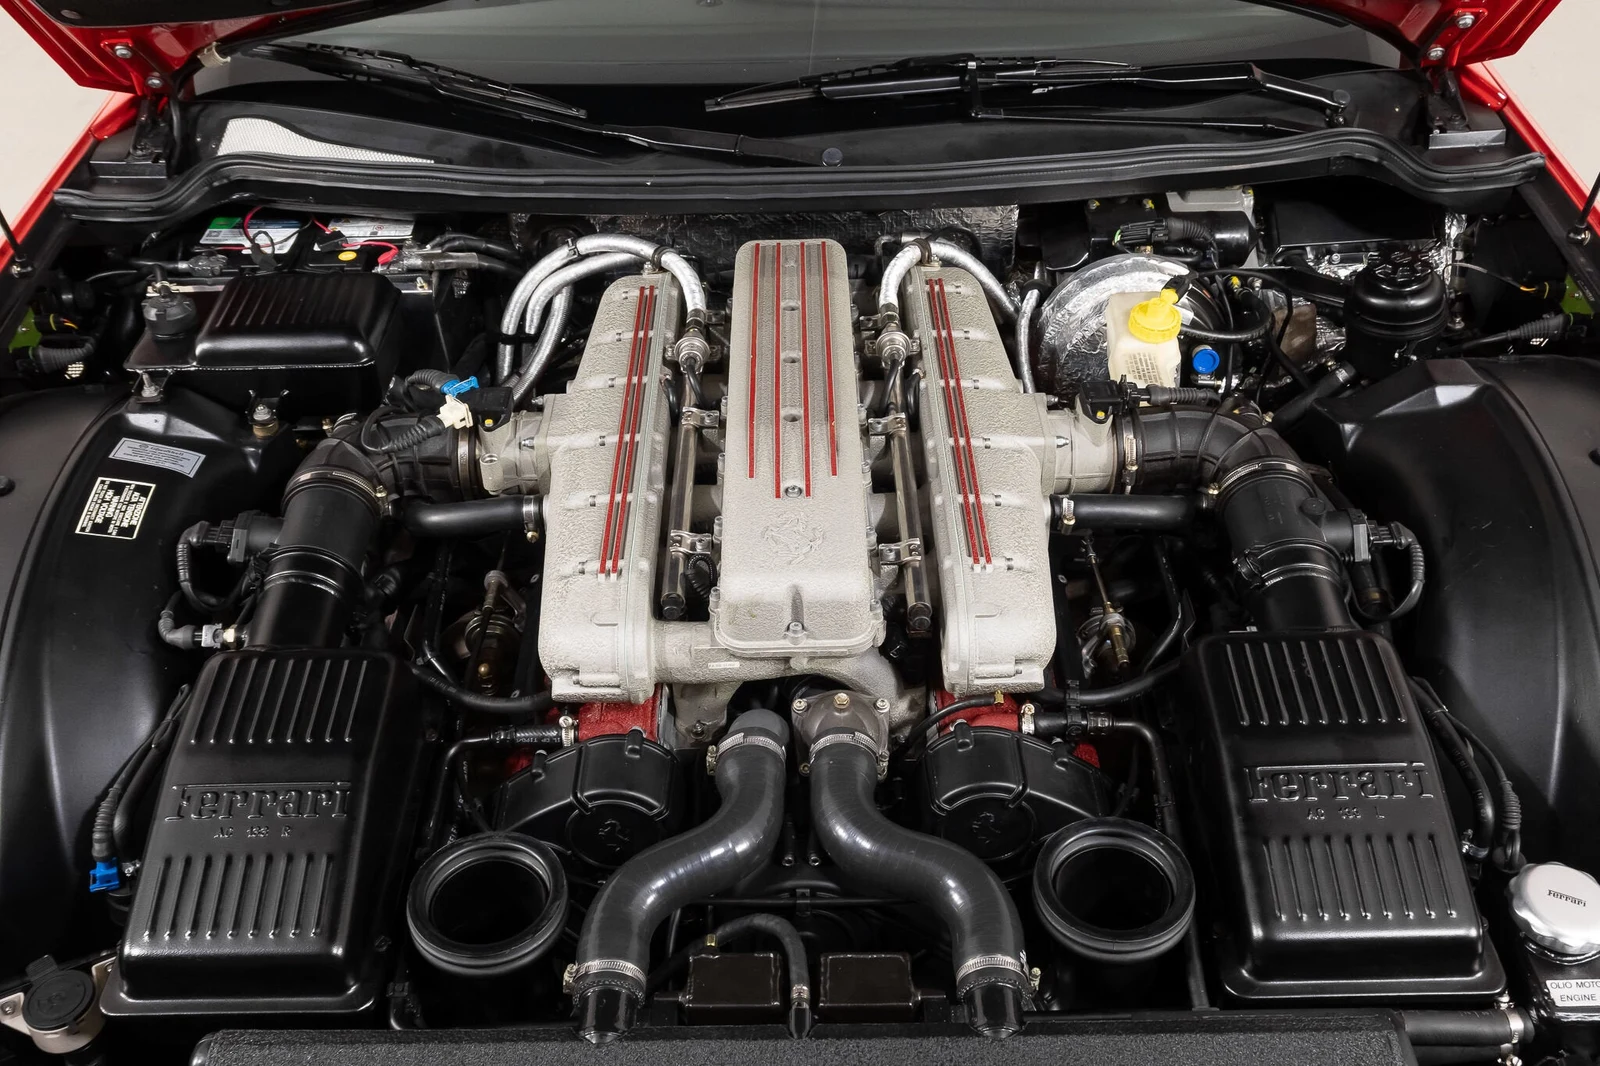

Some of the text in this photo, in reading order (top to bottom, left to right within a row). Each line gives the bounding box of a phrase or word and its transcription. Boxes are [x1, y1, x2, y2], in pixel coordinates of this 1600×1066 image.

[1244, 762, 1433, 803] Ferrari
[165, 782, 351, 821] Ferrari
[1547, 889, 1587, 907] Ferrari
[1550, 981, 1573, 989] OLIO
[1560, 994, 1597, 1002] ENGINE
